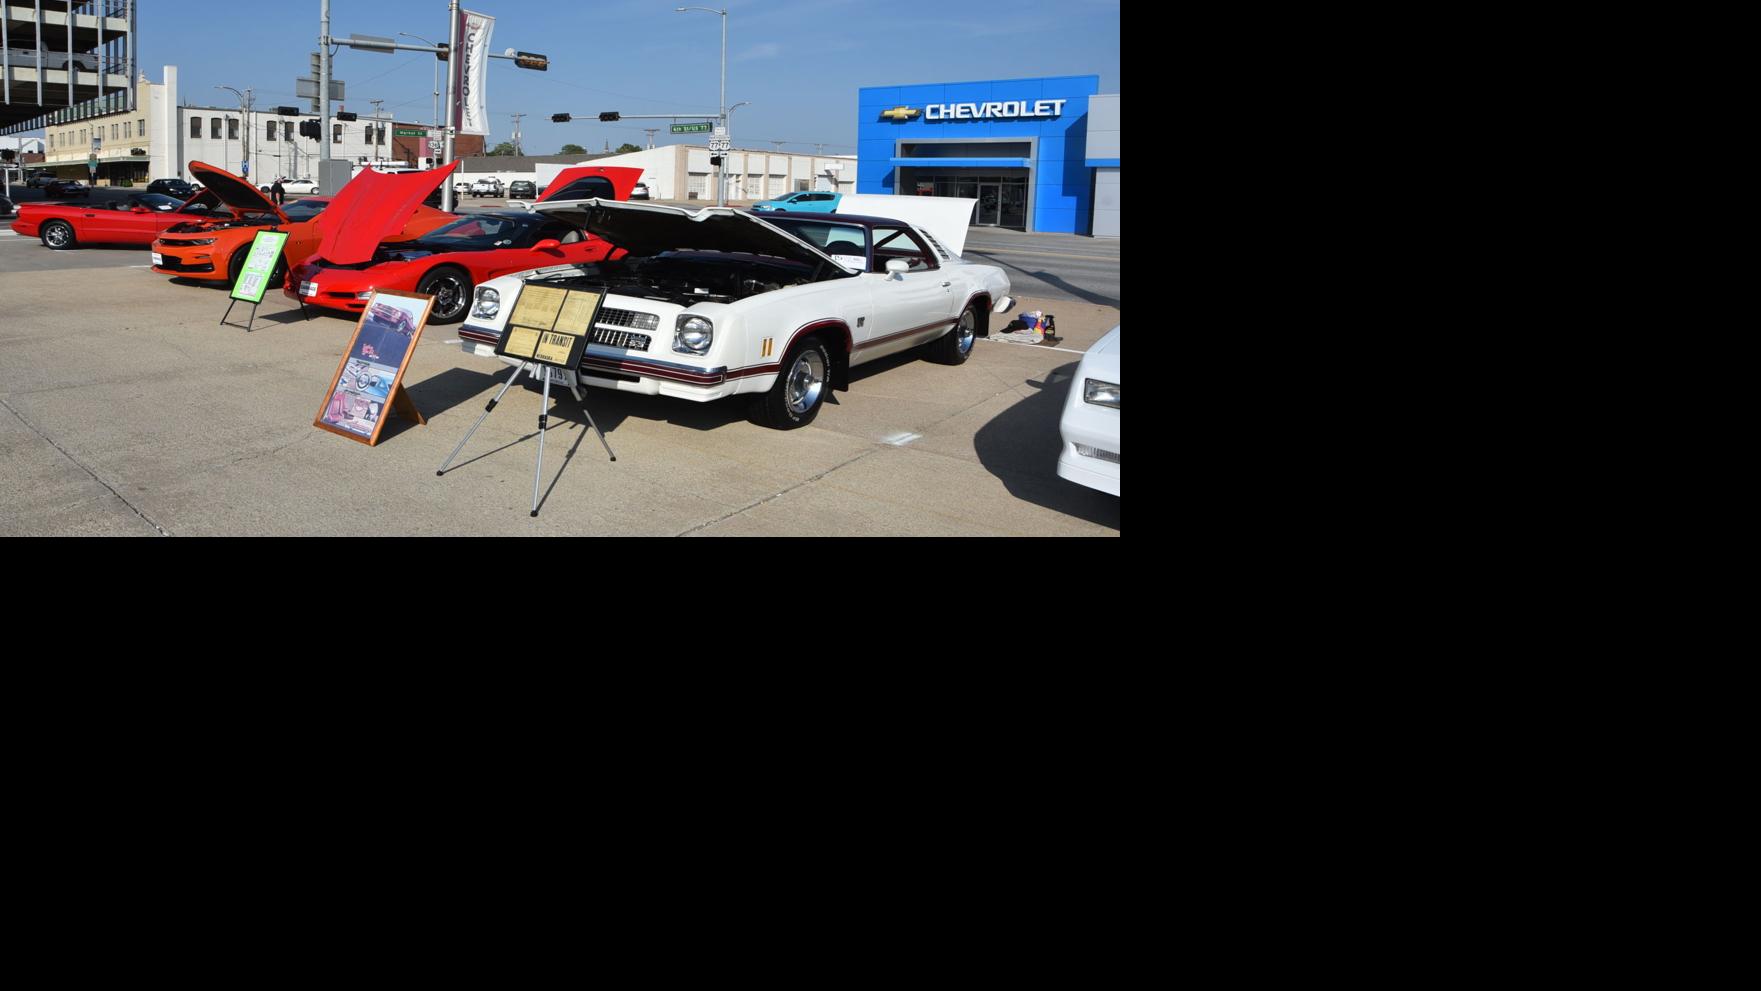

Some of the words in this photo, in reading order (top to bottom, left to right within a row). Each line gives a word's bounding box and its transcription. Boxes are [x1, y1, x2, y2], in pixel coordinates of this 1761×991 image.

[462, 33, 475, 127] CHEVROLET
[925, 99, 1067, 120] CHEVROLET
[541, 333, 548, 344] IN
[549, 333, 573, 348] TRANSIT
